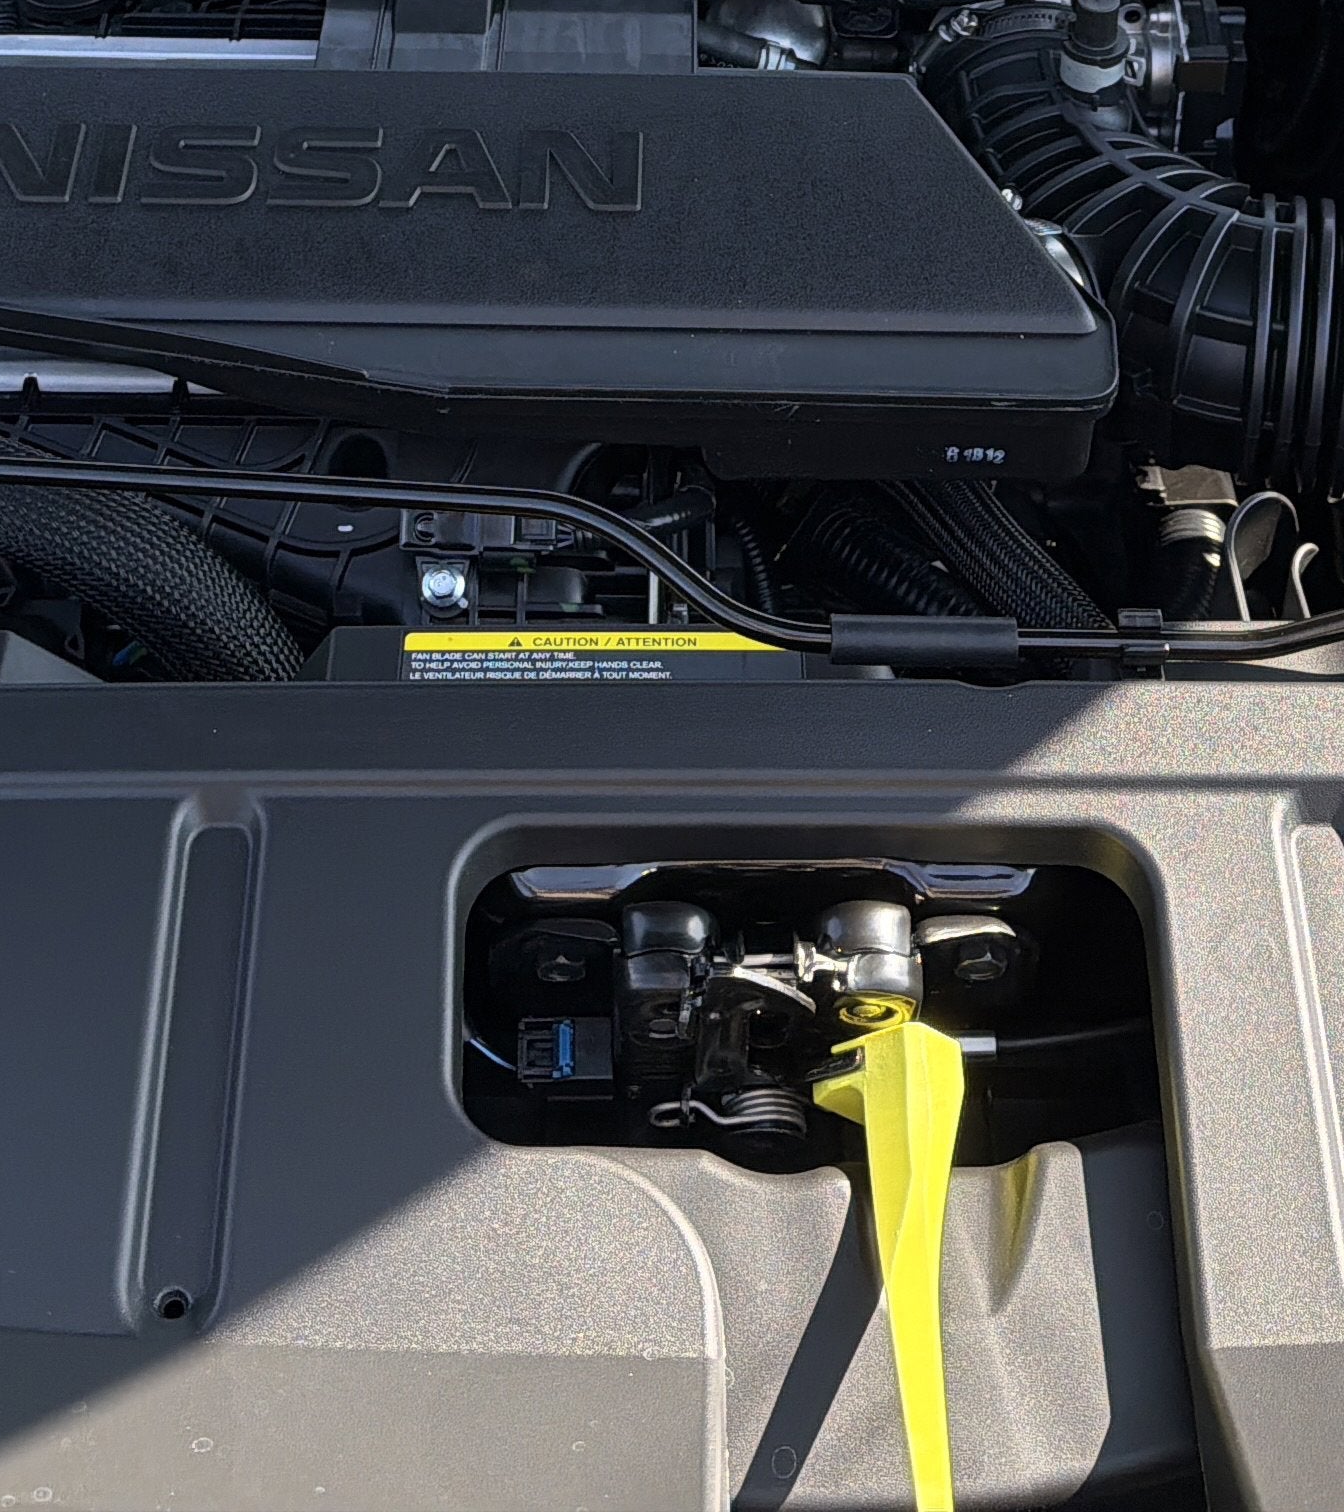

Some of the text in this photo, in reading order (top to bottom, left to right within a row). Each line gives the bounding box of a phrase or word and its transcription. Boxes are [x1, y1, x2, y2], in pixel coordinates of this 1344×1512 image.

[532, 637, 697, 647] CAUTION / ATTENTION
[411, 652, 430, 660] FAN
[432, 652, 463, 660] BLADE
[465, 652, 485, 660] CAN
[487, 652, 516, 660] START
[518, 652, 530, 660] AT
[532, 652, 551, 660] ANY
[410, 661, 424, 669] TO
[426, 661, 450, 669] HELP
[452, 661, 482, 669] AVOID
[483, 661, 534, 669] PERSONAL
[595, 661, 628, 669] HANDS
[539, 669, 591, 679] DÉMARRER
[602, 671, 627, 679] TOUT
[629, 671, 672, 679] MOMENT.
